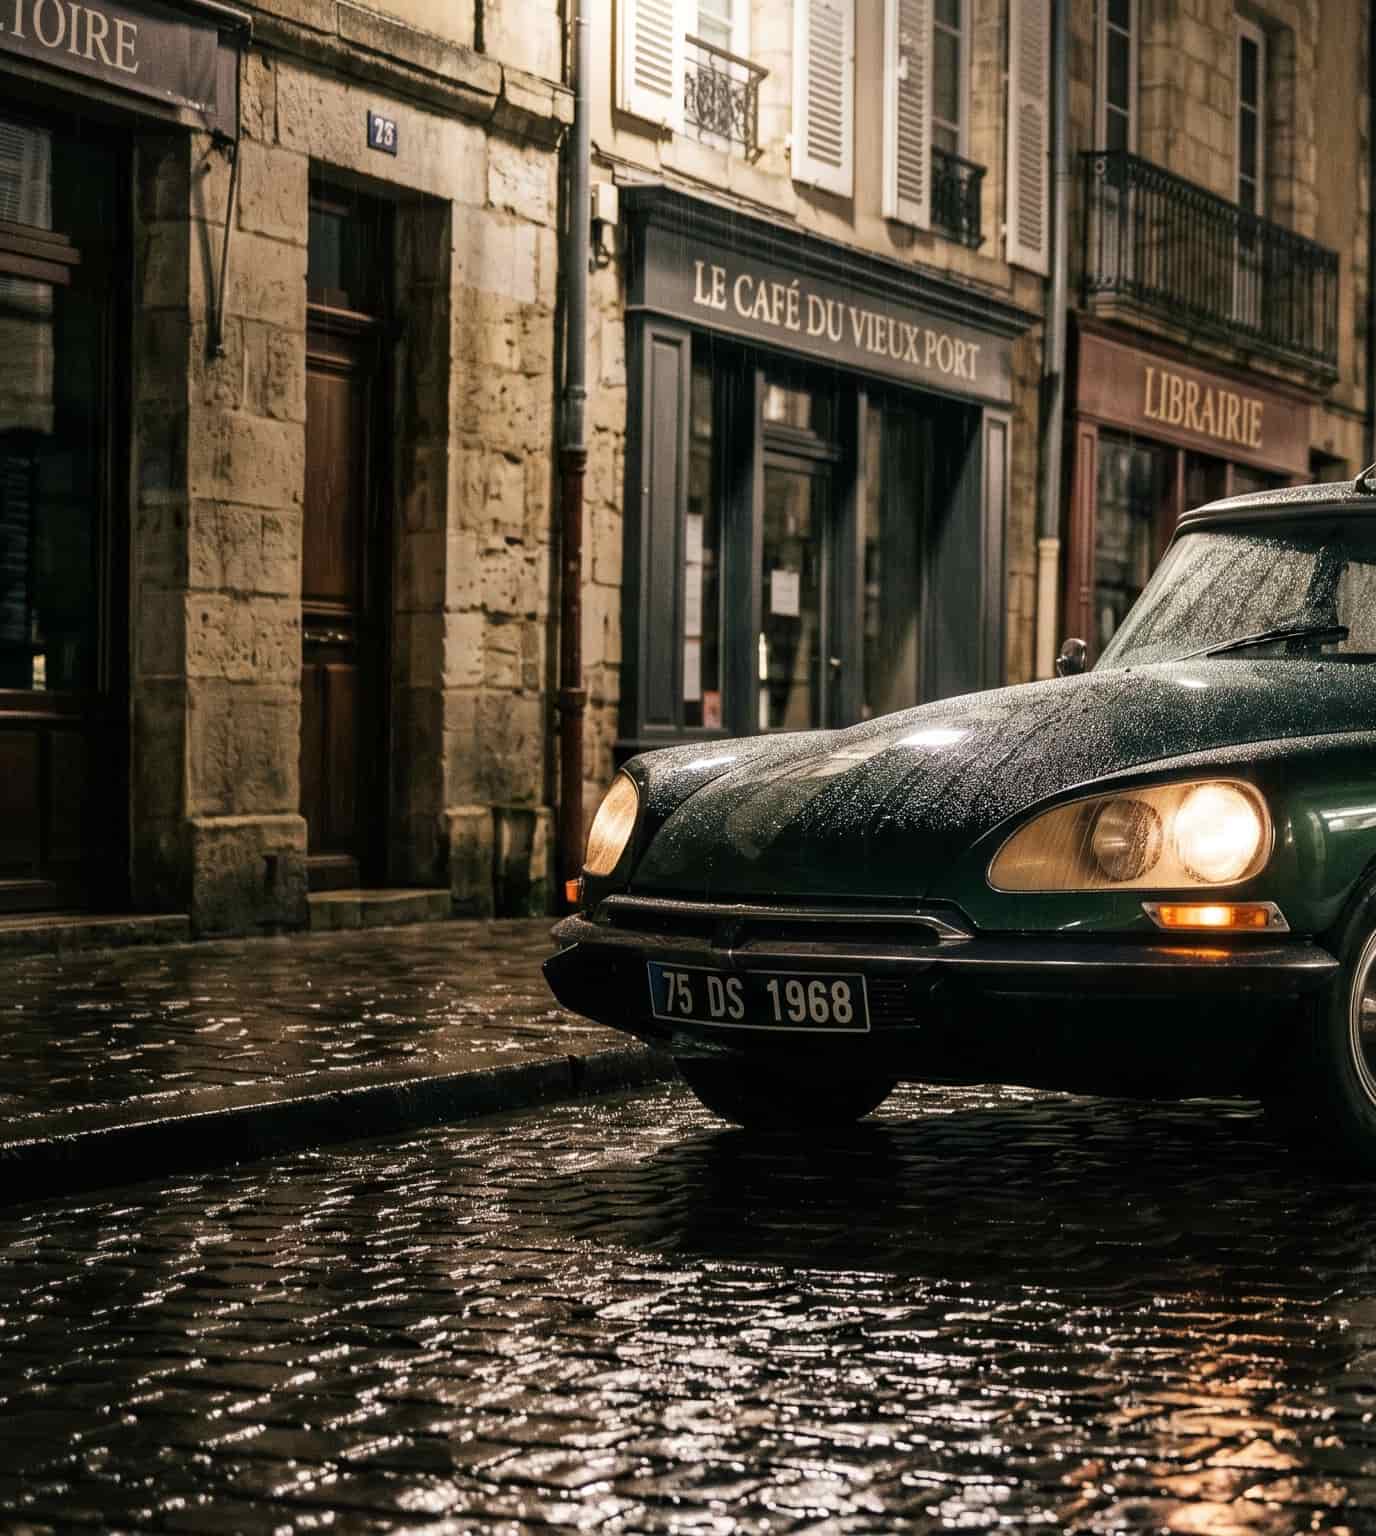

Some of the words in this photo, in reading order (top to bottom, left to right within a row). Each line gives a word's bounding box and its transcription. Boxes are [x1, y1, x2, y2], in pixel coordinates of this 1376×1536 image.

[0, 0, 139, 74] TOIRE
[692, 260, 728, 311] LE
[733, 275, 801, 331] CAFÉ
[806, 294, 845, 341] DU
[849, 306, 920, 365] VIEUX
[923, 329, 981, 381] PORT
[1144, 366, 1265, 449] LIBRAIRIE
[662, 971, 694, 1015] 75
[706, 975, 746, 1020] DS
[766, 978, 854, 1024] 1968
